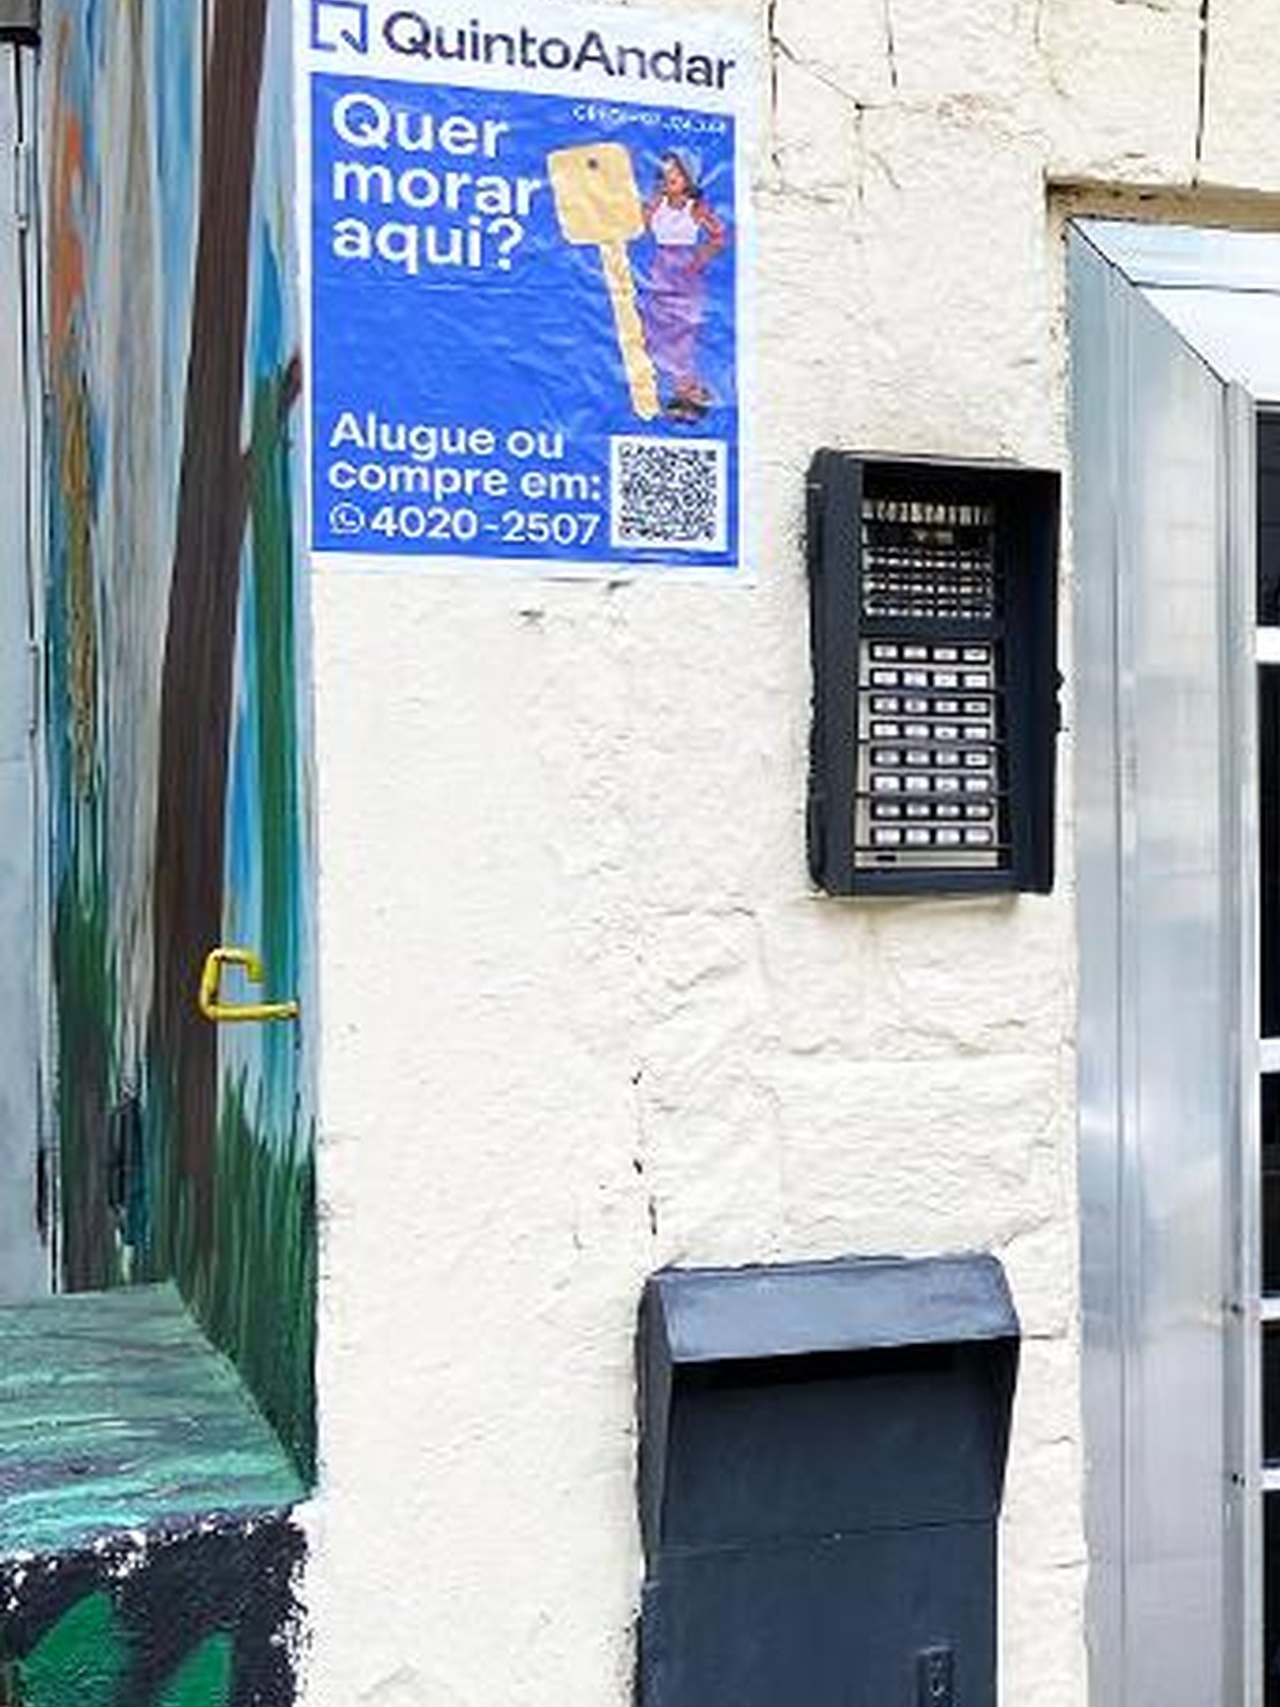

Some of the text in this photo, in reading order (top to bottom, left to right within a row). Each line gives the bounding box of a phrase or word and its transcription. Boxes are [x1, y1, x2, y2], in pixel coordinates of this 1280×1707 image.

[382, 10, 737, 90] QuintoAndar
[332, 92, 508, 157] Quer
[332, 161, 541, 217] morar
[332, 216, 525, 274] aqui?
[329, 412, 564, 460] Alugue ou
[328, 461, 602, 501] compre em:
[370, 505, 600, 545] 4020-2507
